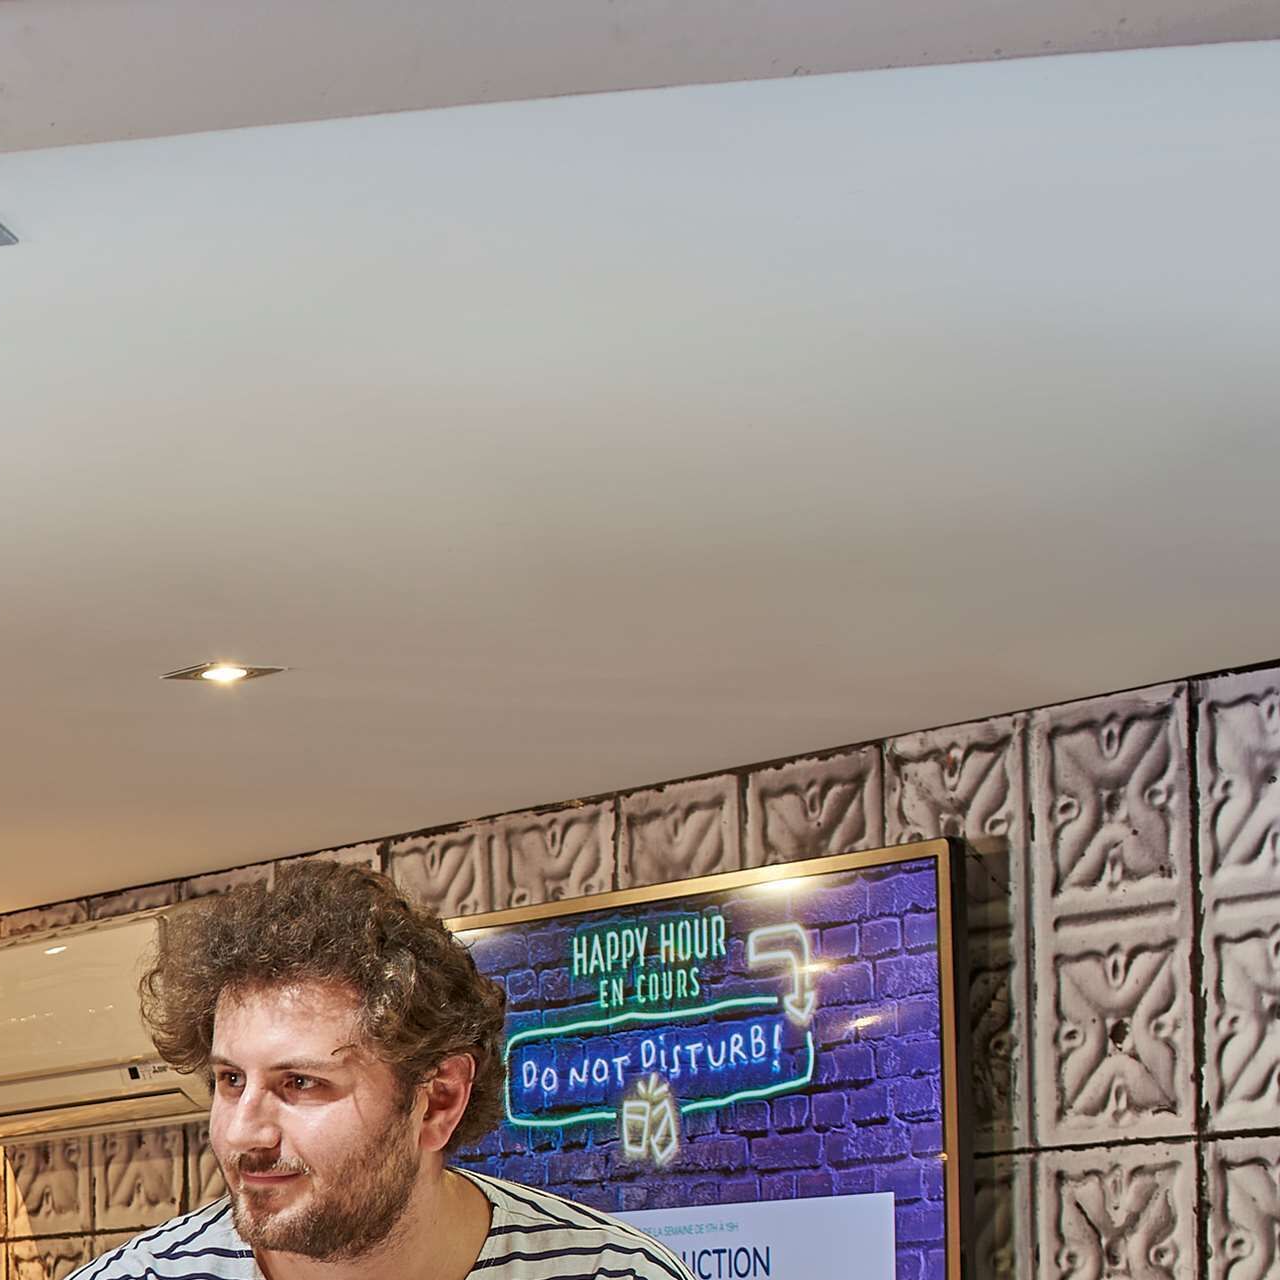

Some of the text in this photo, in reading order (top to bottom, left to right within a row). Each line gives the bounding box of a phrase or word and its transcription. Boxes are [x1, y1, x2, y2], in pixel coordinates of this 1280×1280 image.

[573, 915, 727, 976] HAPPY HOUR
[600, 968, 701, 1008] EN COURS
[522, 1061, 558, 1092] DO
[569, 1055, 632, 1087] NOT
